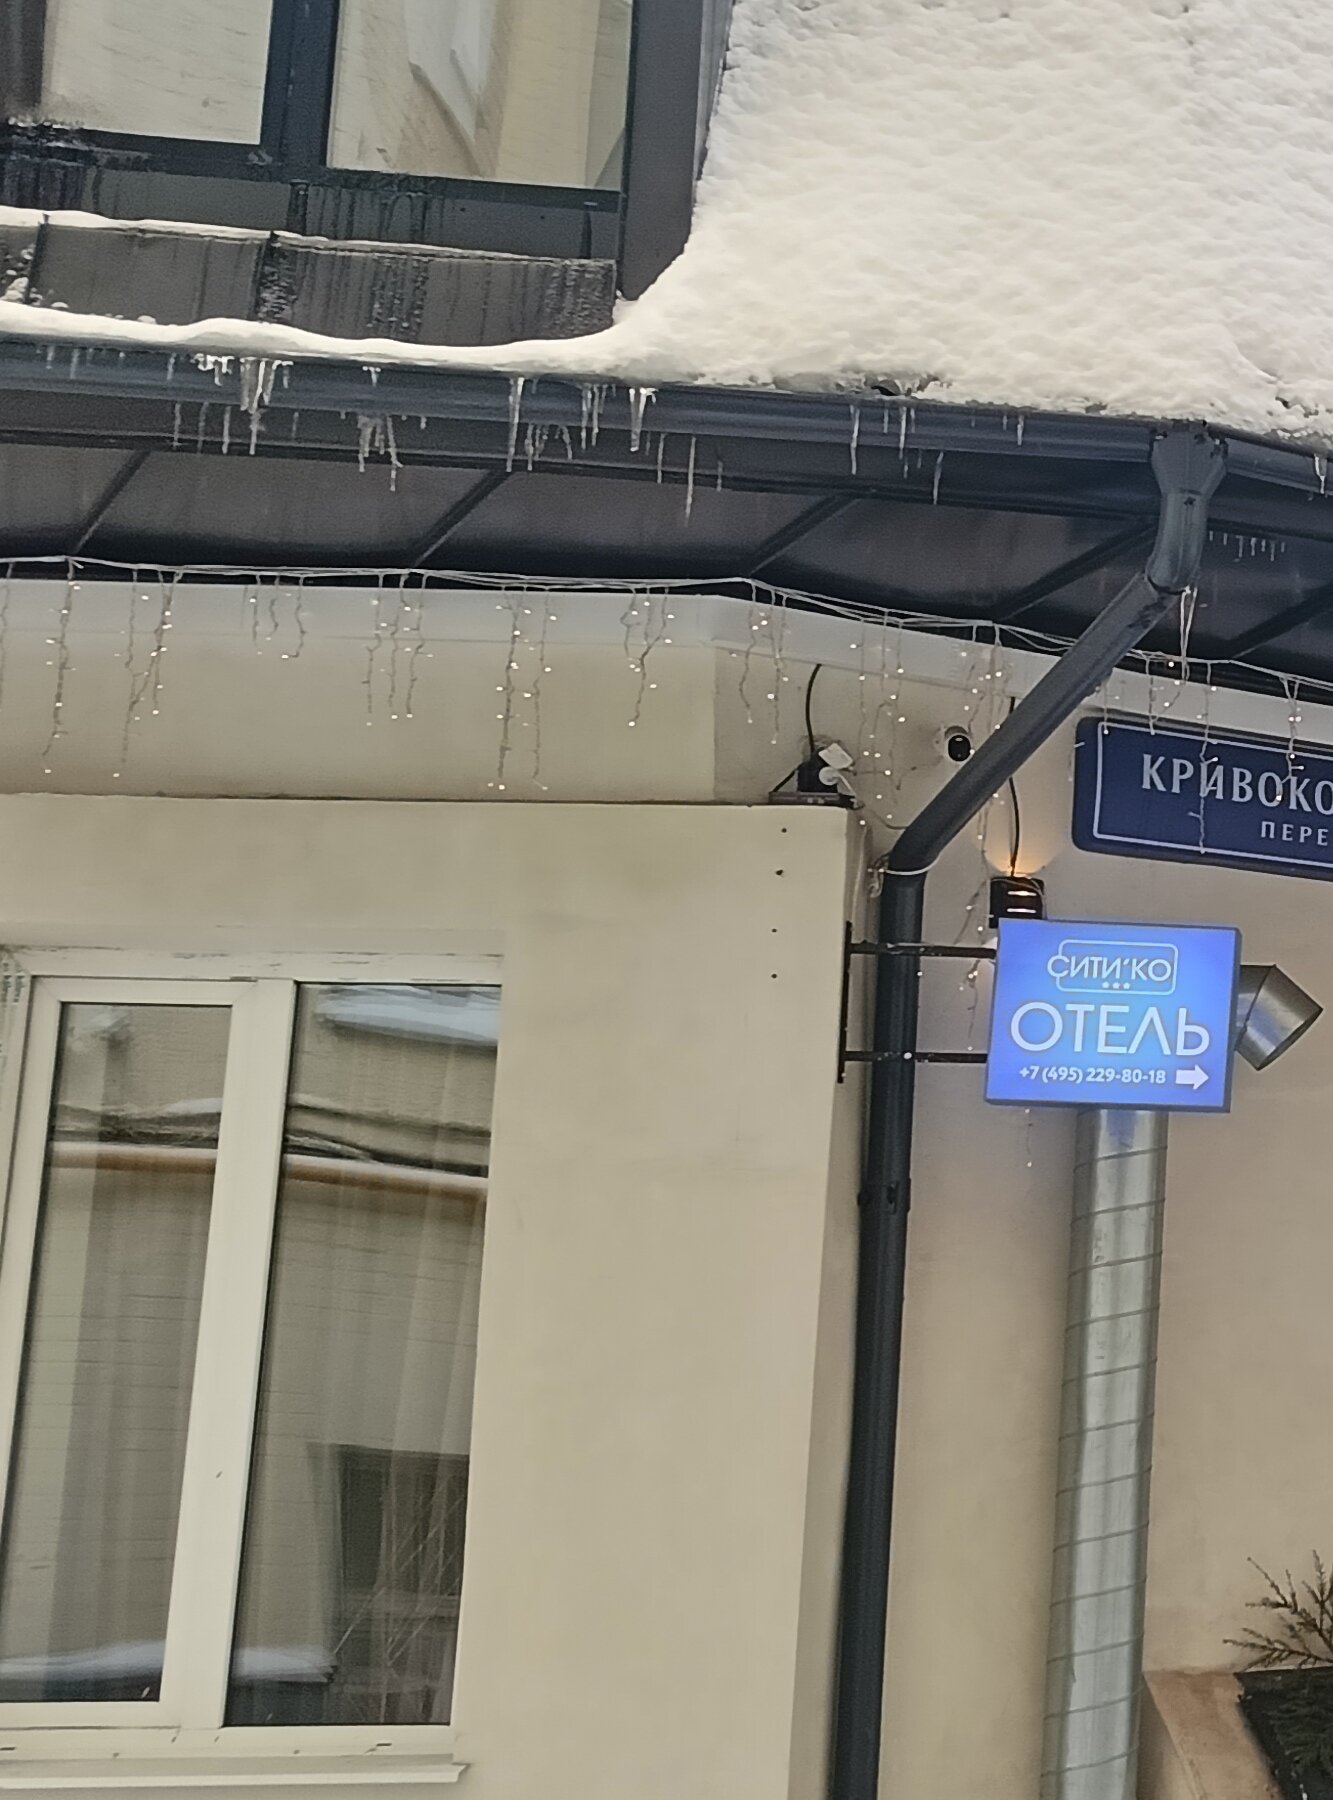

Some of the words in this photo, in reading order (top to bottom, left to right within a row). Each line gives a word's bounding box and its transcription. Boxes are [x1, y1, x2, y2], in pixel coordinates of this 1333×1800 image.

[1010, 1001, 1210, 1056] ОТЕЛЬ
[1019, 1065, 1040, 1080] +7
[1042, 1066, 1083, 1084] (495)
[1085, 1067, 1166, 1084] 229-80-18
